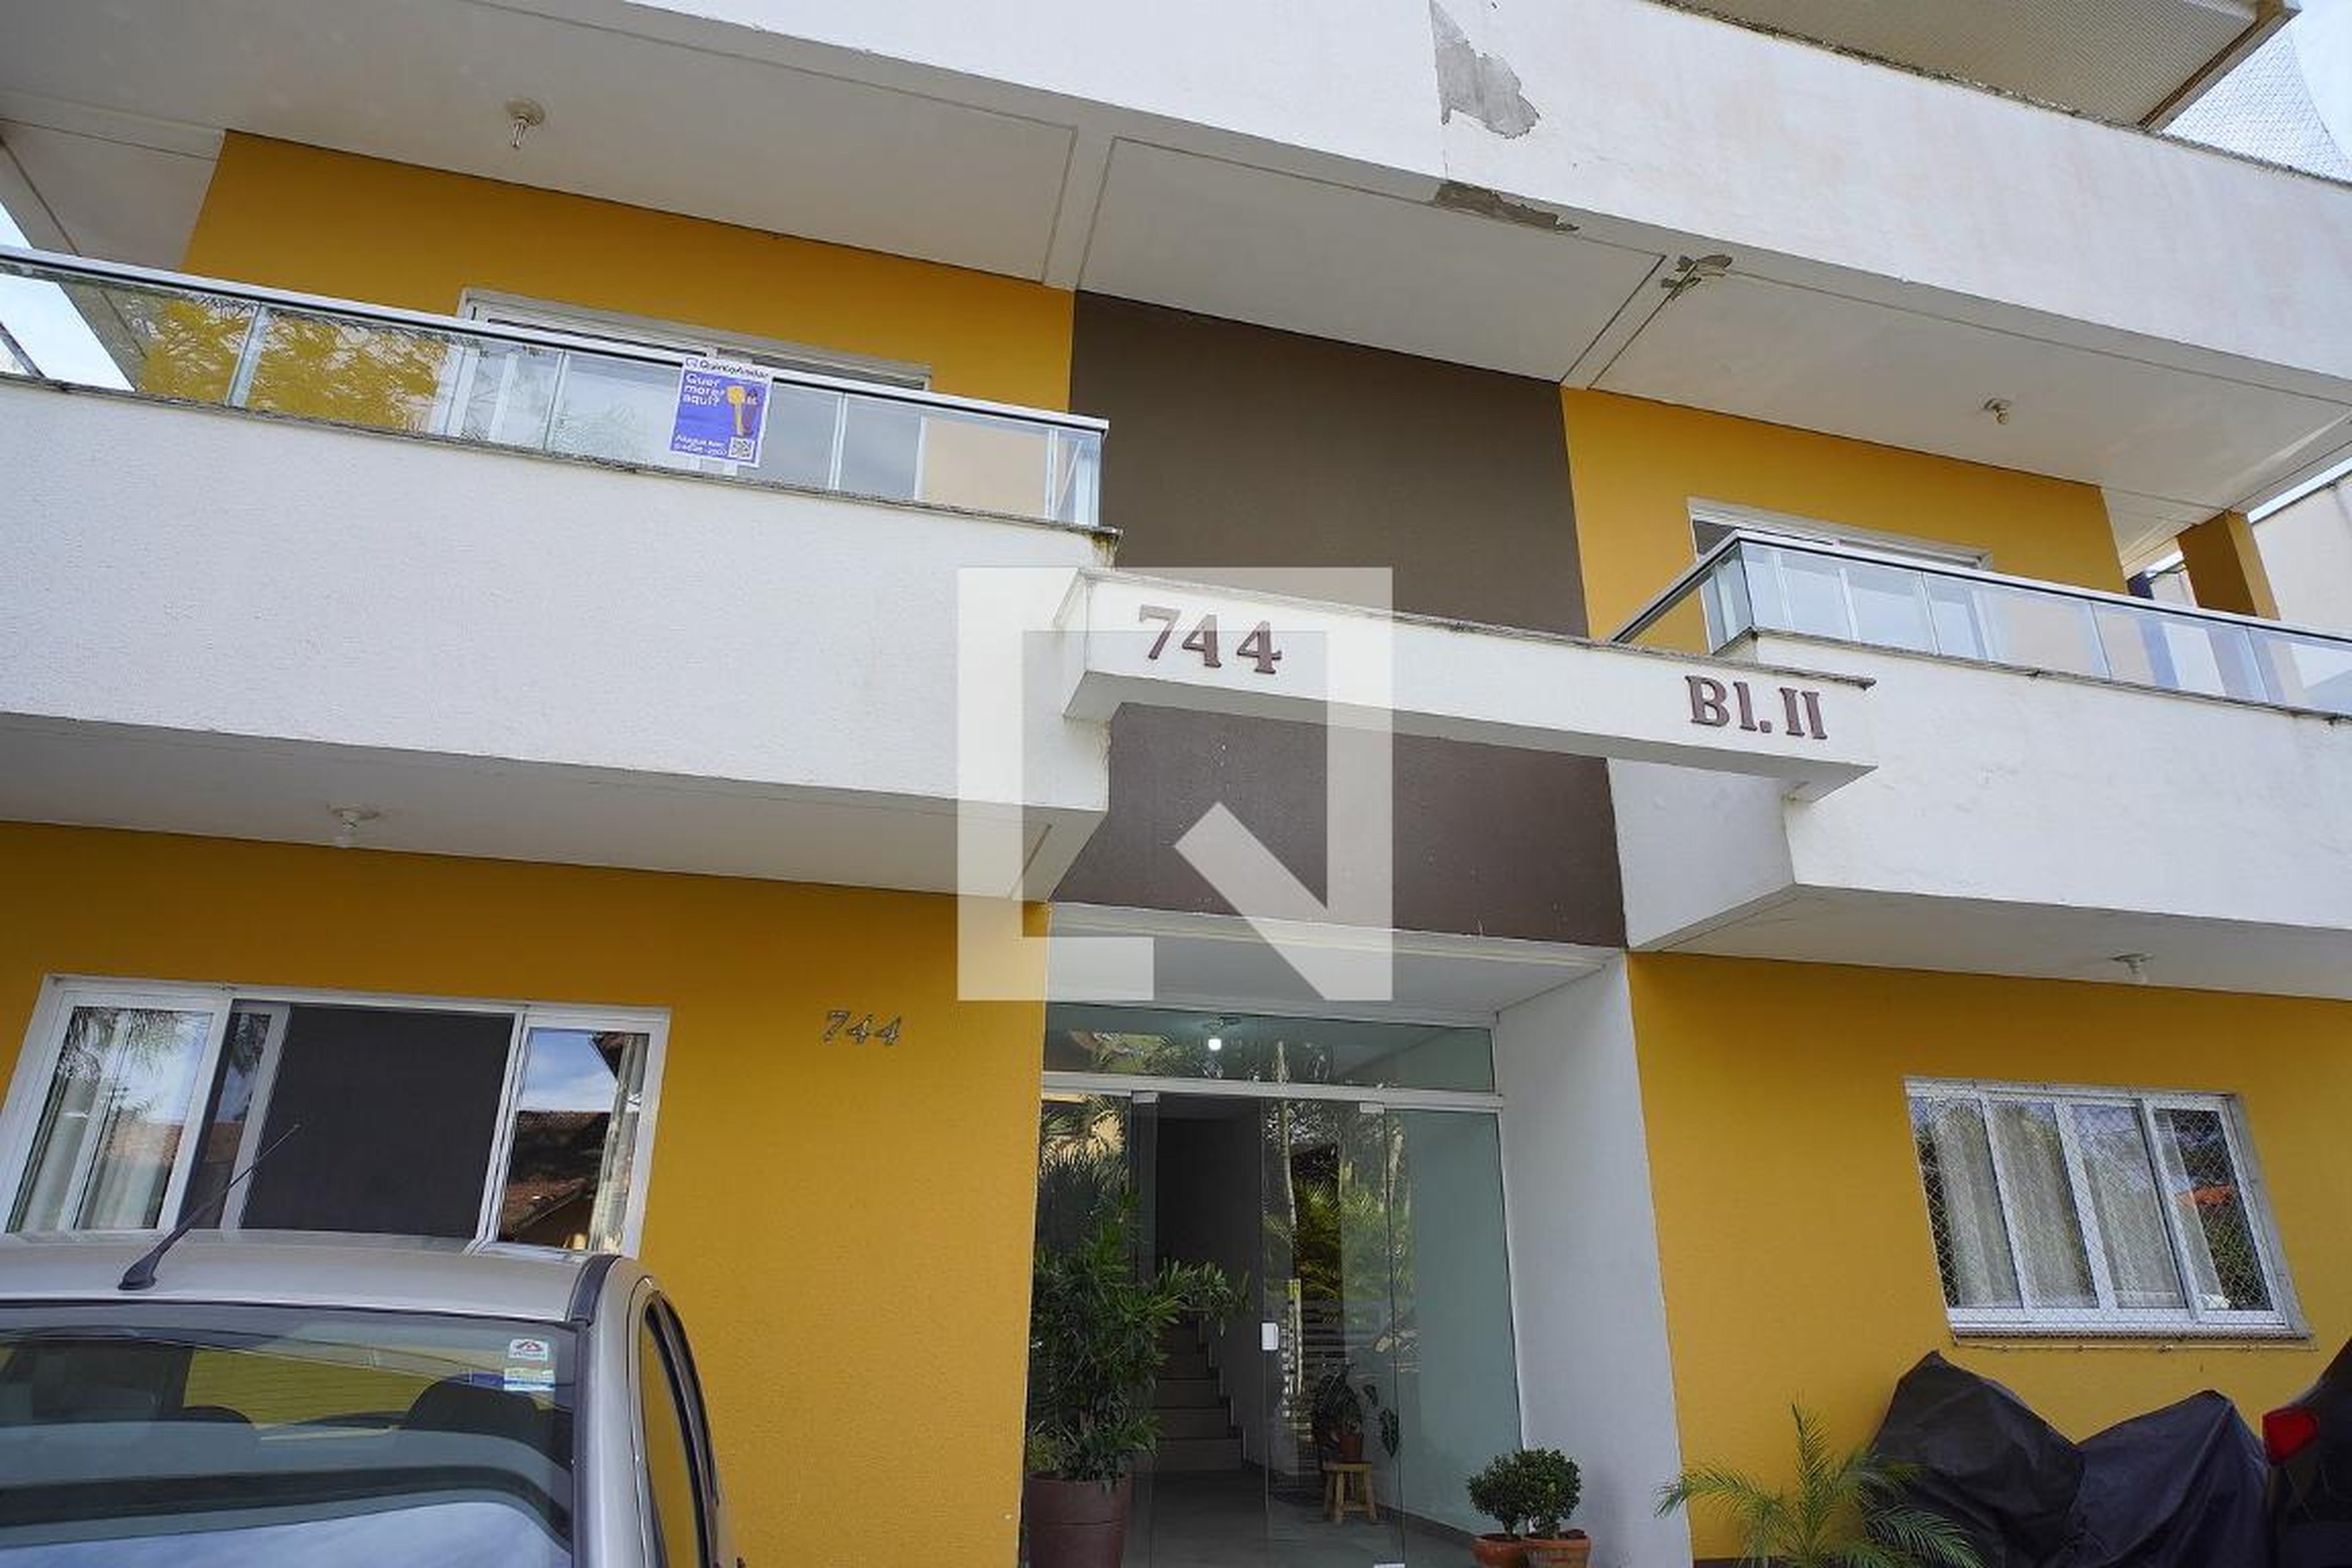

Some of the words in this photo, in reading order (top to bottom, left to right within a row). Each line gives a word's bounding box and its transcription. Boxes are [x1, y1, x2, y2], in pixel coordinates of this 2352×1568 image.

[685, 373, 720, 387] Quer
[1139, 604, 1283, 674] 744
[823, 1010, 901, 1046] 744
